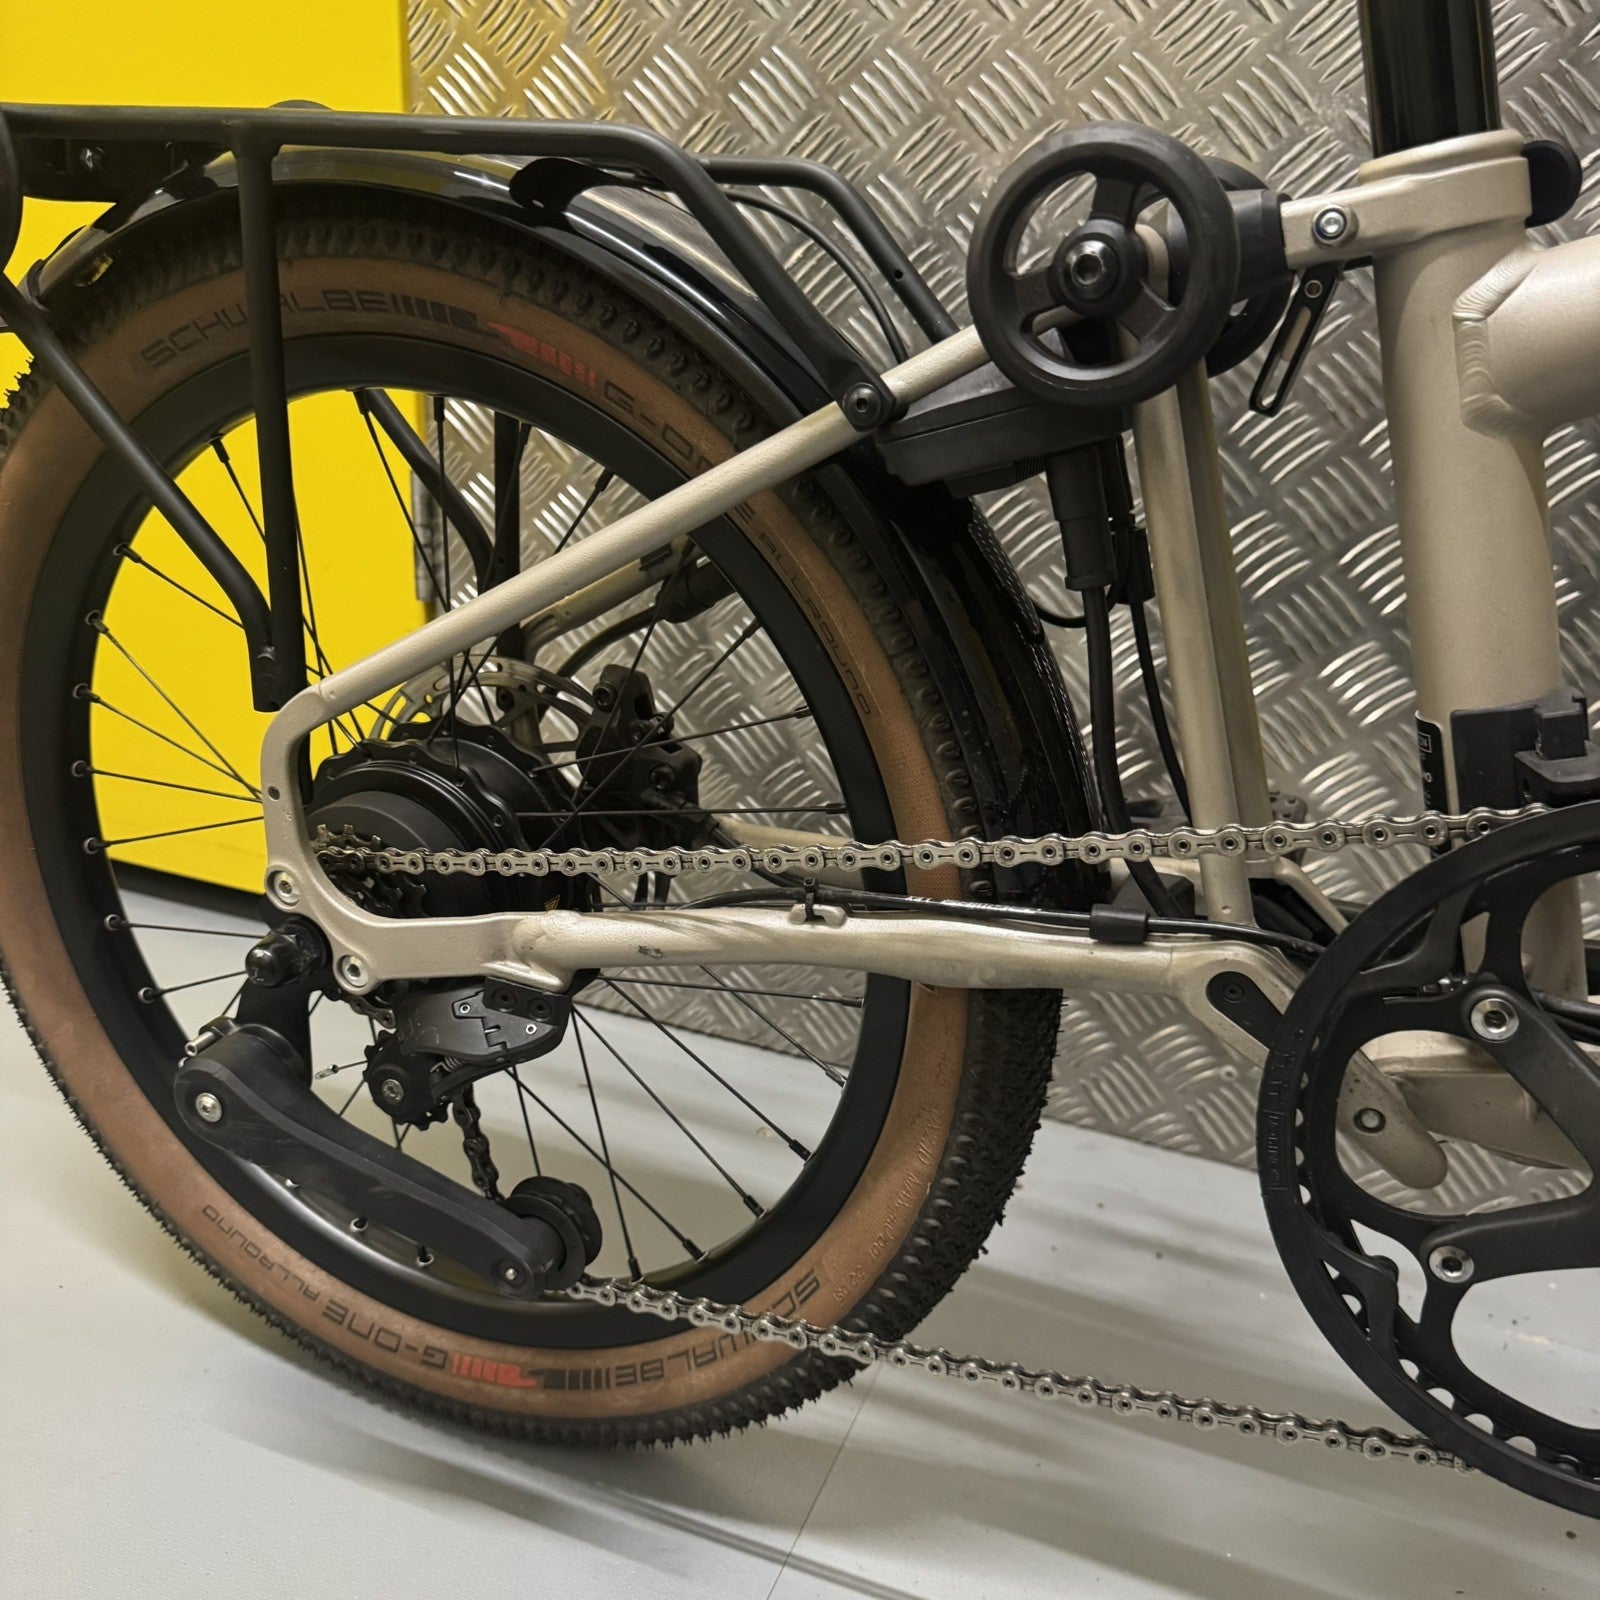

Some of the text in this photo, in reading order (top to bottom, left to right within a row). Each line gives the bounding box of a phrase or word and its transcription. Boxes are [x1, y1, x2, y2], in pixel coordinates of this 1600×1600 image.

[759, 532, 871, 716] ALLROUND
[202, 1203, 449, 1370] G-ONE ALLROUND
